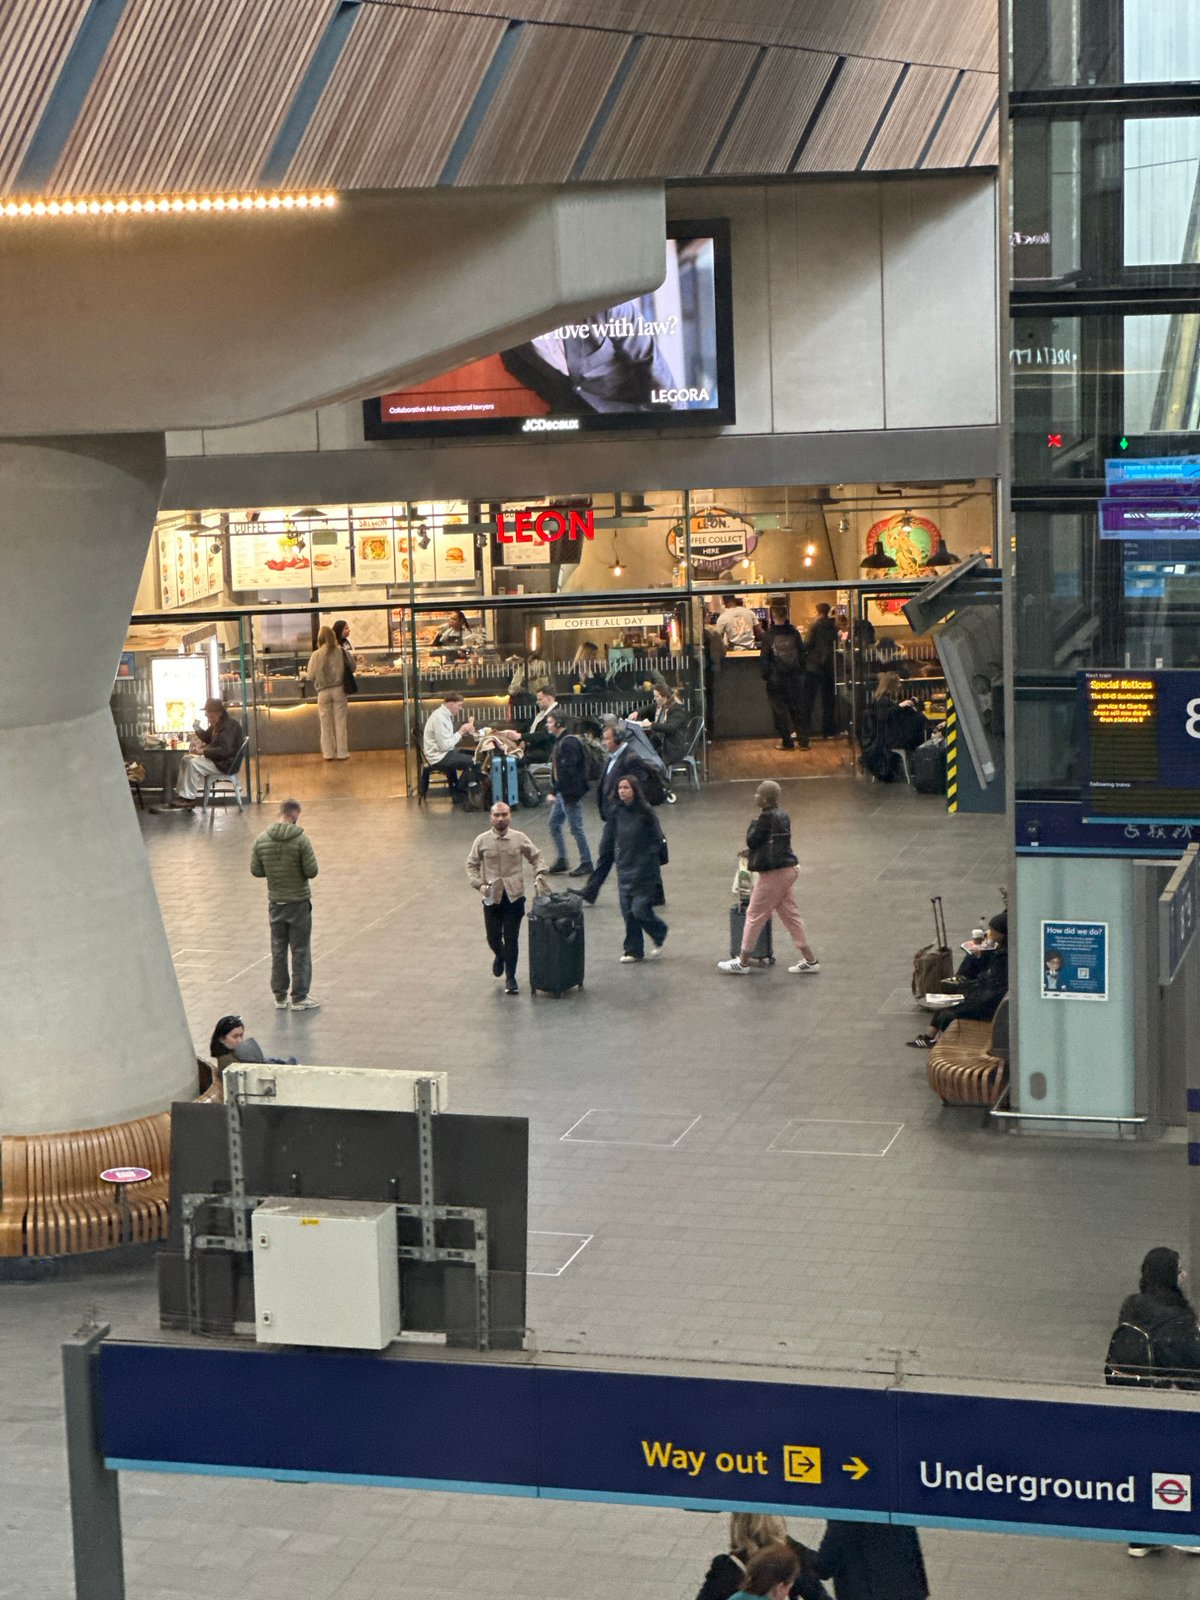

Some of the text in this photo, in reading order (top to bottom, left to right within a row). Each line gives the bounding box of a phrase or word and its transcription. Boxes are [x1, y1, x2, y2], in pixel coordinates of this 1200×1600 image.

[591, 318, 635, 338] with
[637, 315, 678, 336] law?
[651, 388, 710, 403] LEGORA
[388, 405, 426, 415] Collaborative
[441, 404, 473, 413] exceptional
[473, 403, 495, 412] lawyers
[522, 419, 579, 432] JCDecaux
[496, 510, 595, 543] LEON
[678, 535, 743, 545] CFFEE COLLECT
[702, 547, 720, 555] HERE
[565, 617, 644, 628] COFFEE ALL DAY
[1090, 680, 1153, 690] Special Notices
[1185, 697, 1200, 739] 8
[1046, 926, 1063, 935] How
[1064, 927, 1076, 935] did
[1089, 928, 1103, 937] do?
[641, 1440, 1135, 1502] Way out Underground
